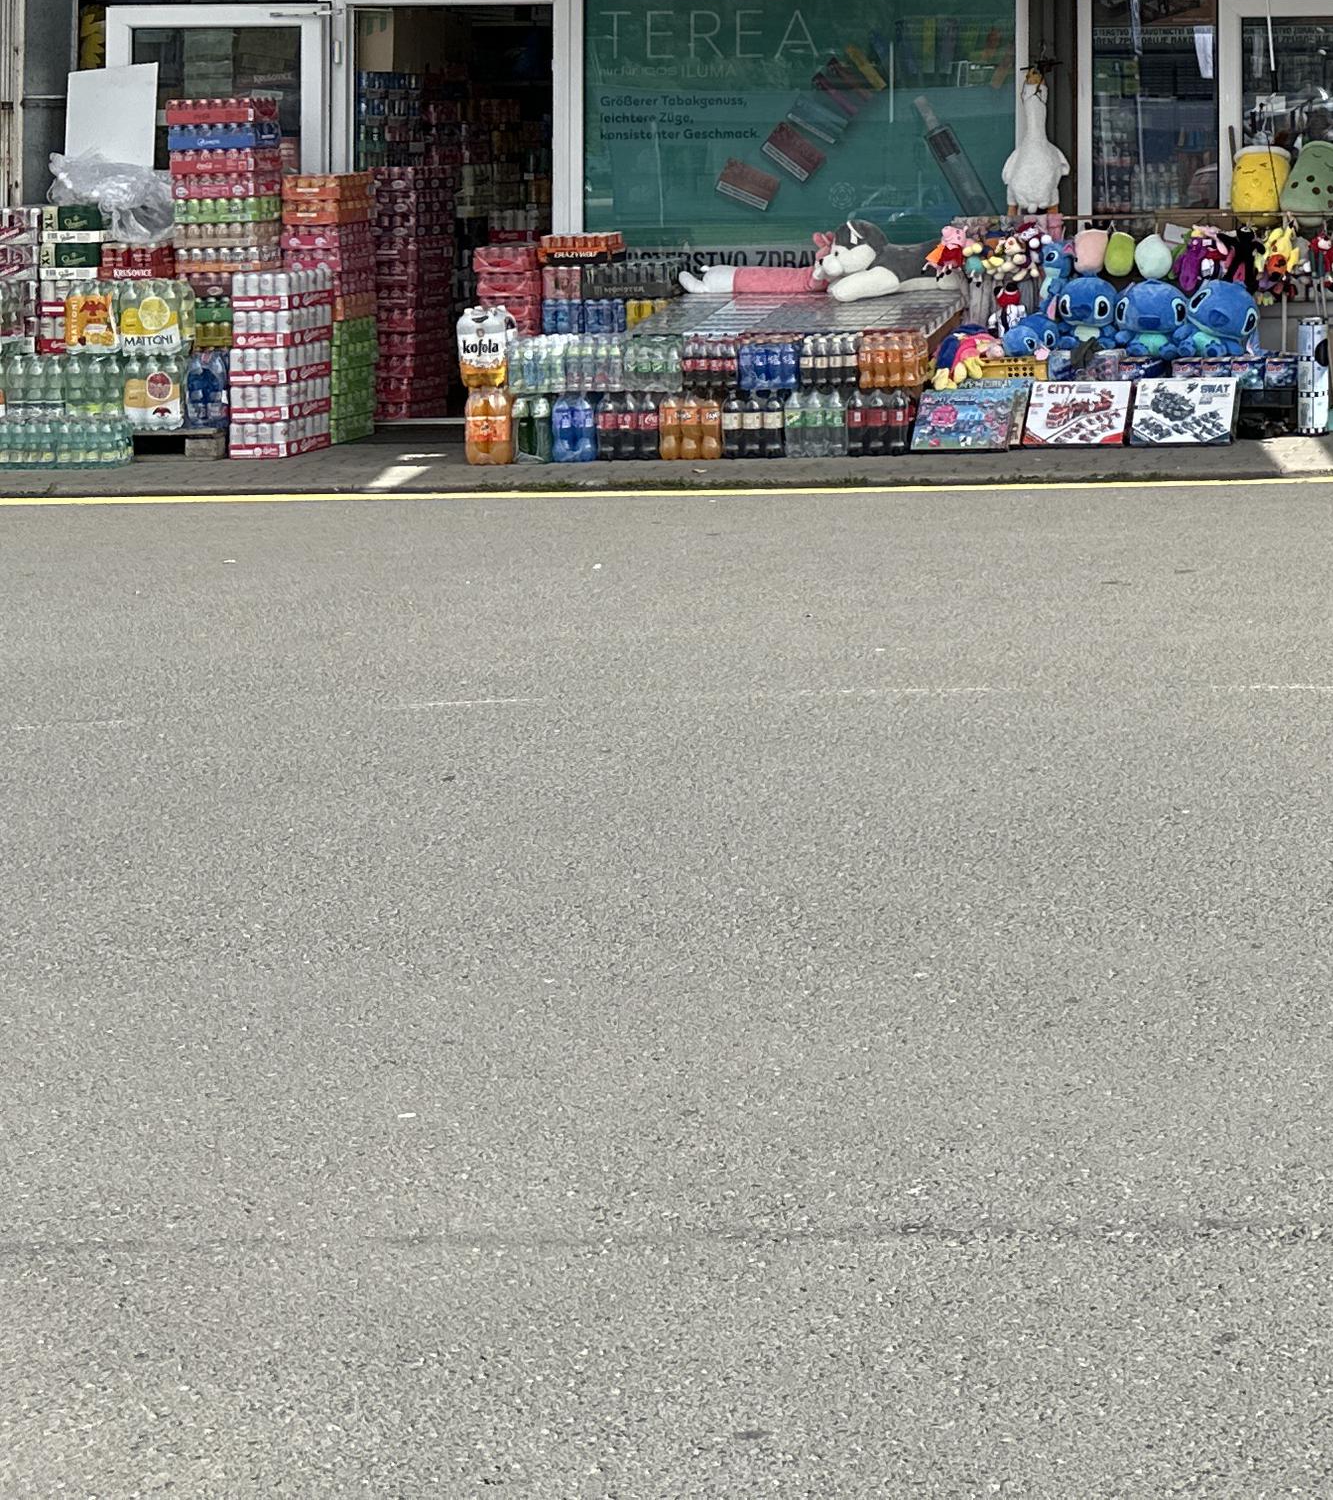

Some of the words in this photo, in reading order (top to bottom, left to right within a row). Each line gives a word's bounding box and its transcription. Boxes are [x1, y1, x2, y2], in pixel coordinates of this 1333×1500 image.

[599, 9, 820, 60] TEREA
[680, 63, 738, 78] ILUMA
[600, 95, 658, 107] Größerer
[660, 95, 748, 109] Tabakgenuss,
[600, 112, 657, 123] leichtere
[659, 112, 695, 126] Züge,
[683, 128, 761, 140] Geschmack.
[124, 334, 174, 347] MATTONI
[462, 338, 500, 357] kofola
[1047, 385, 1074, 394] CITY
[1199, 384, 1231, 394] SWAT
